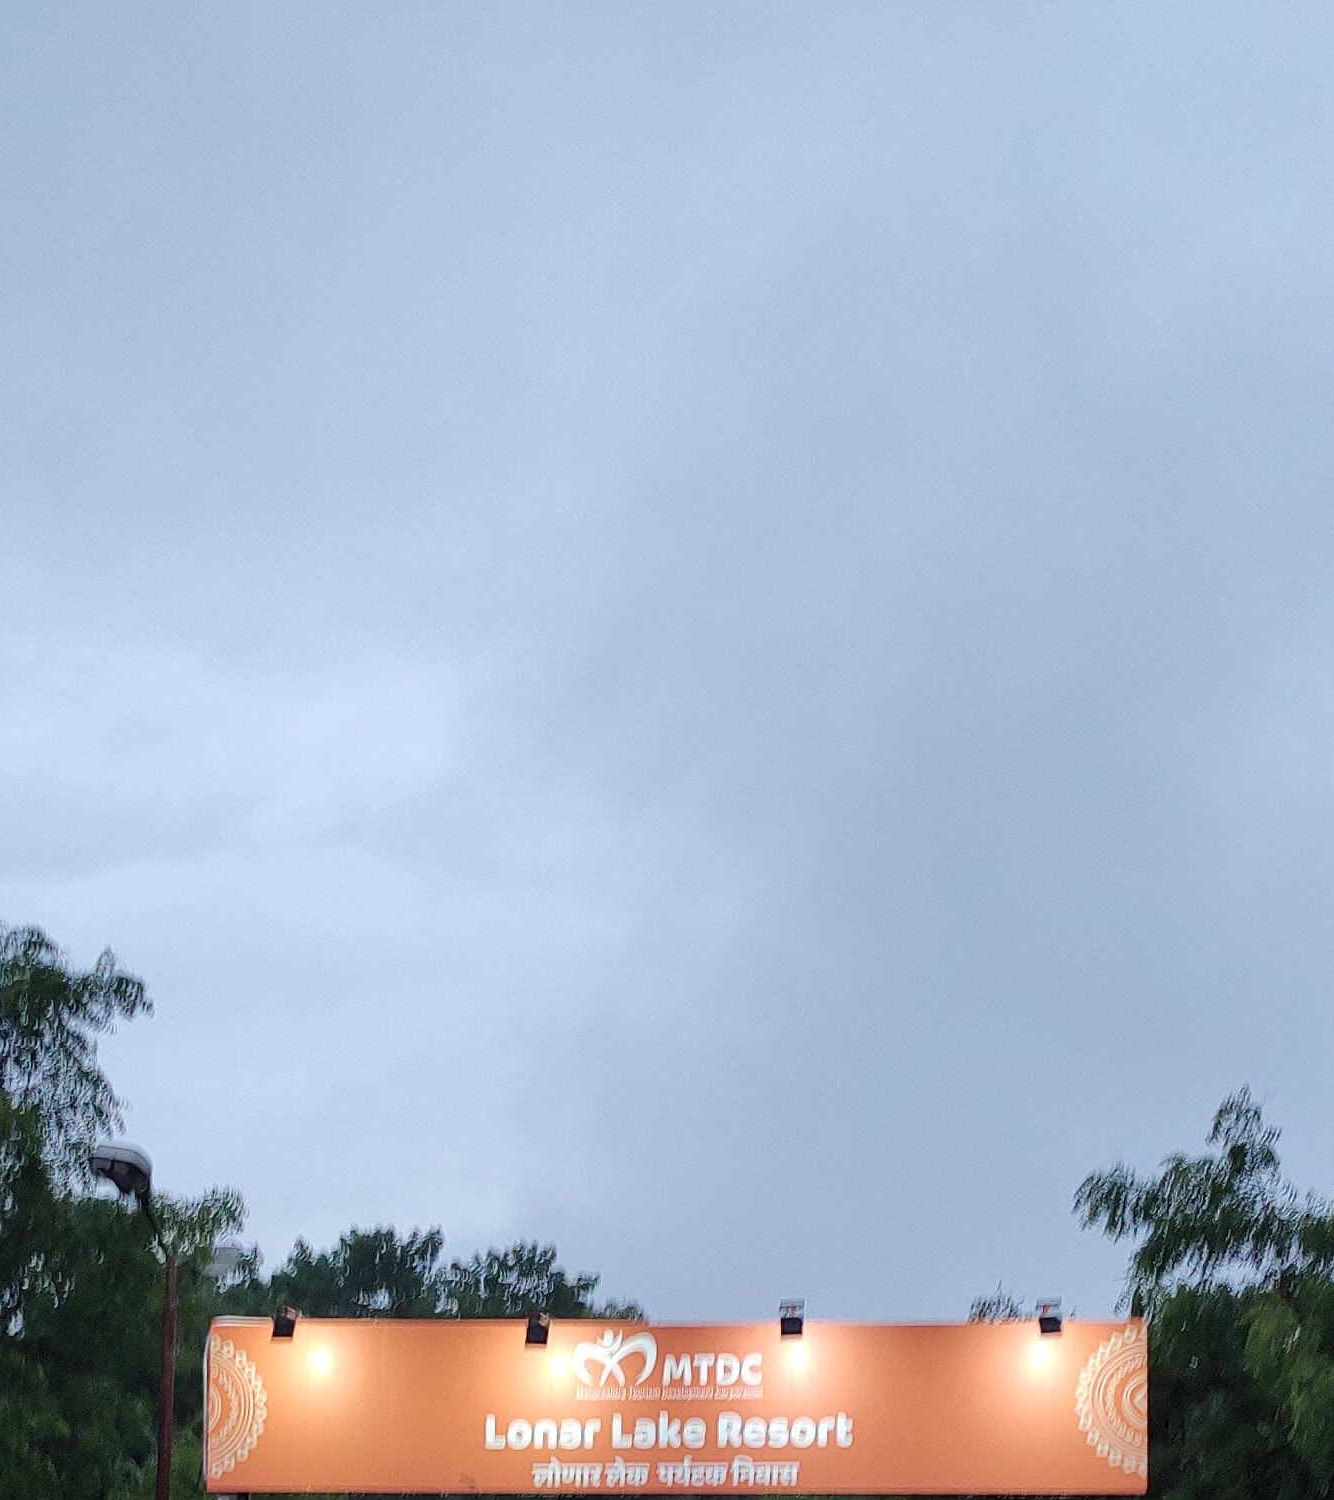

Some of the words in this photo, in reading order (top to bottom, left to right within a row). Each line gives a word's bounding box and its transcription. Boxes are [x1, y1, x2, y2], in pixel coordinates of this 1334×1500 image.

[662, 1352, 763, 1386] MTDC
[485, 1413, 602, 1450] Lonar
[611, 1410, 707, 1449] Lake
[718, 1411, 854, 1449] Resort
